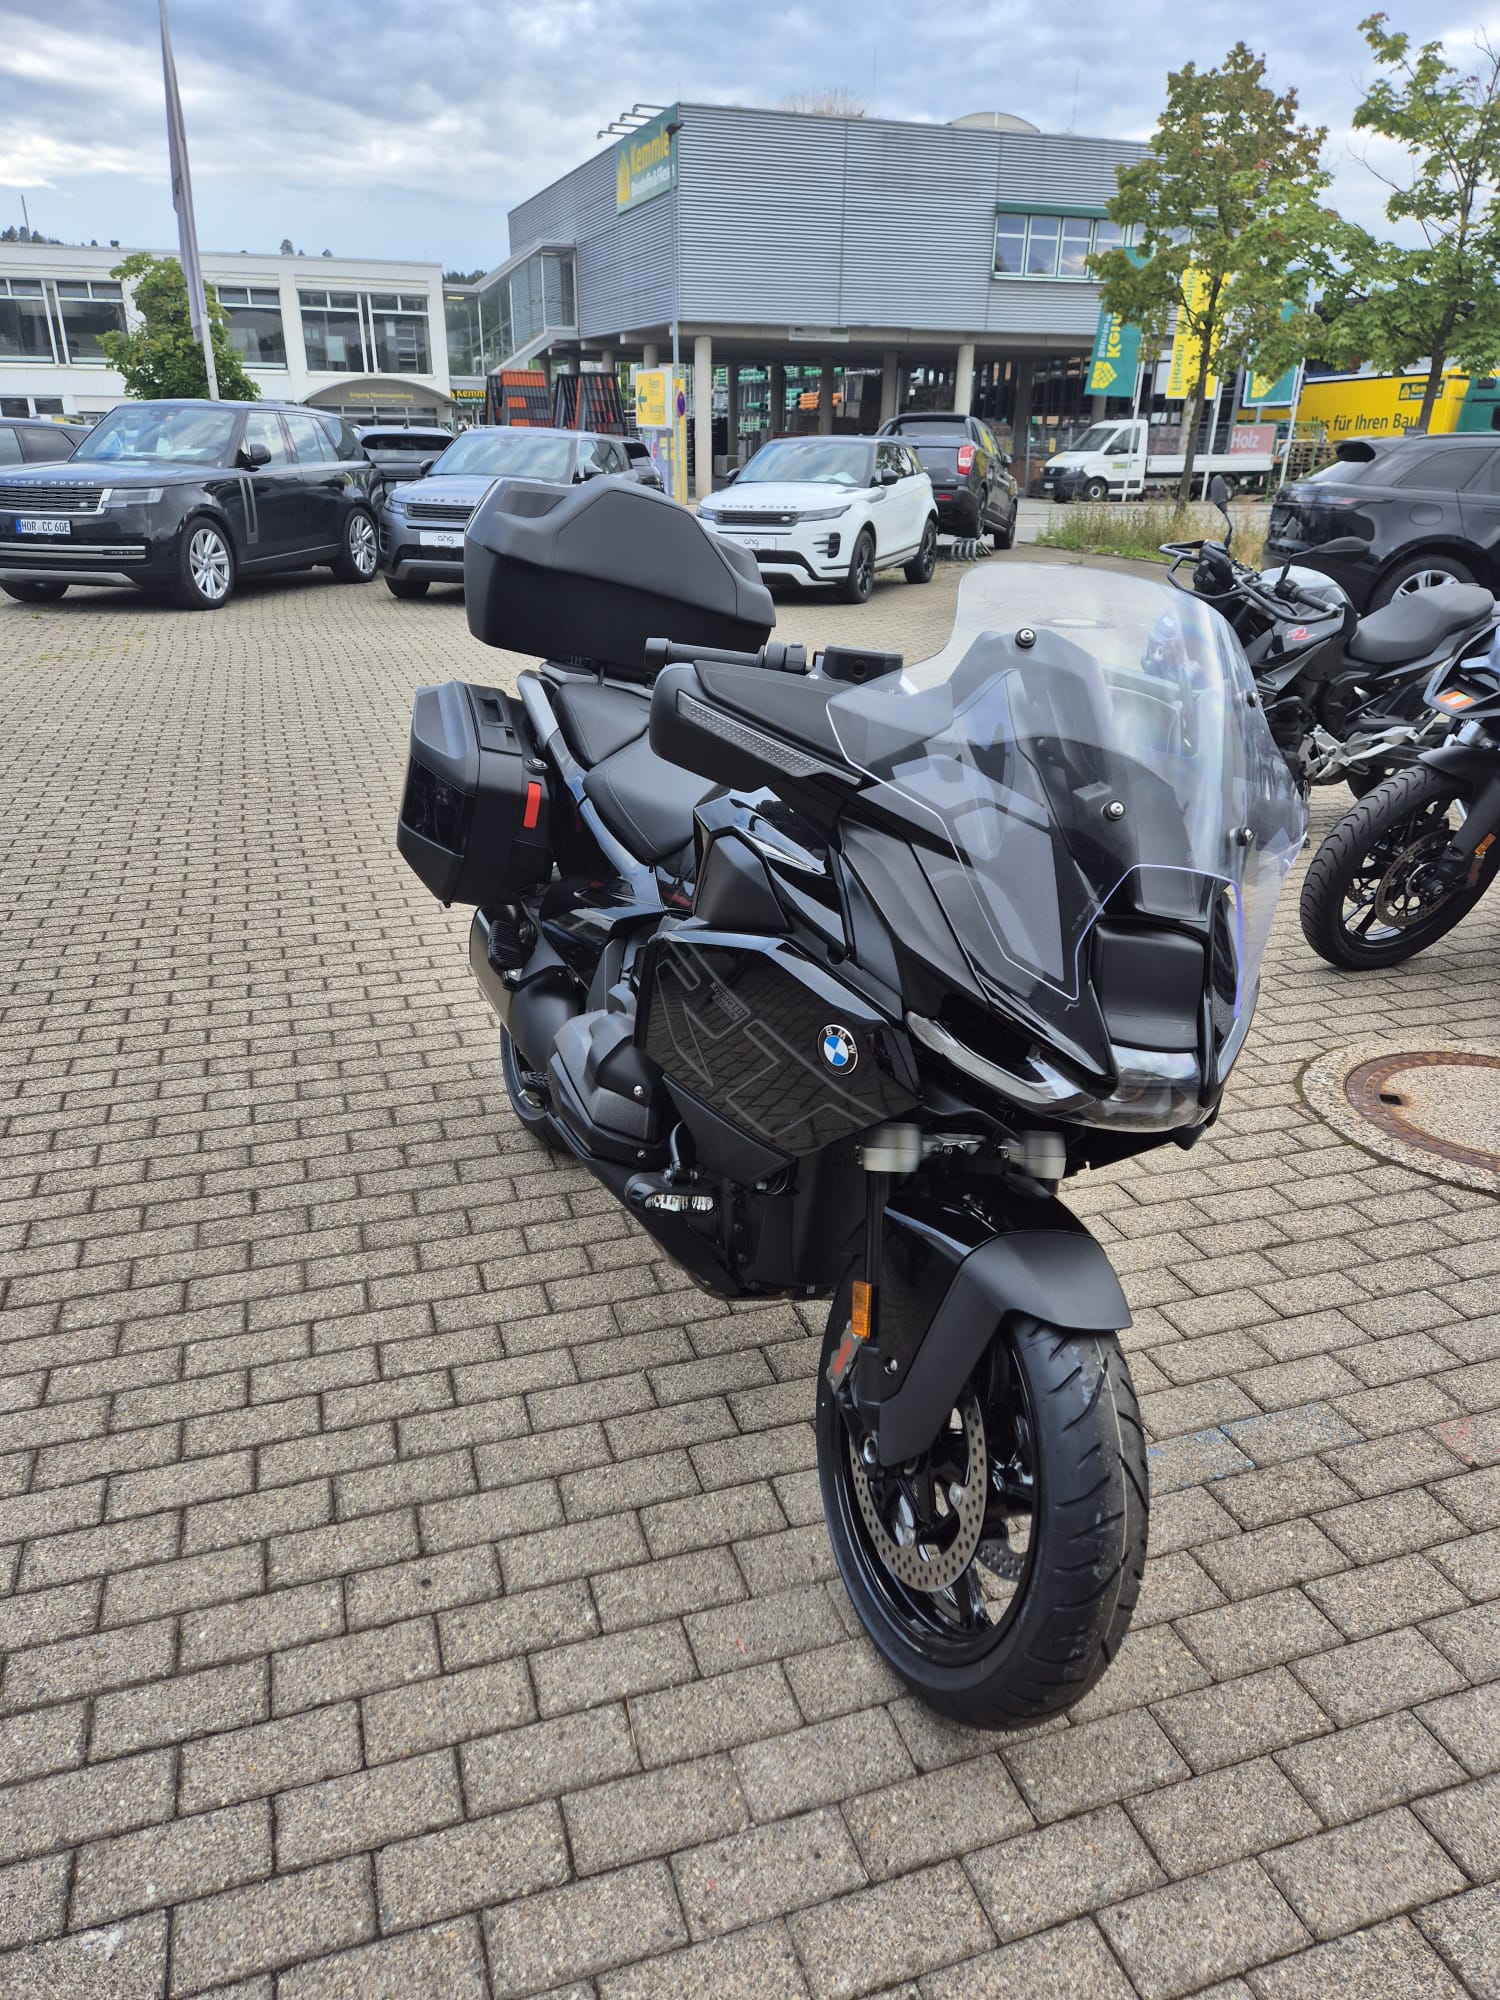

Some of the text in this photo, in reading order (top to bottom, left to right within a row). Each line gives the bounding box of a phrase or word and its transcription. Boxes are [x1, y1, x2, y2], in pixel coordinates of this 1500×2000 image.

[630, 123, 670, 176] Kemmle
[456, 389, 487, 398] Kemm
[1333, 415, 1352, 432] für
[1355, 413, 1389, 430] Ihren
[1230, 430, 1260, 449] Holz
[21, 520, 37, 532] HOR
[42, 521, 53, 532] CC
[437, 534, 455, 545] ahg
[743, 538, 759, 547] ahg
[824, 1026, 857, 1055] BMW
